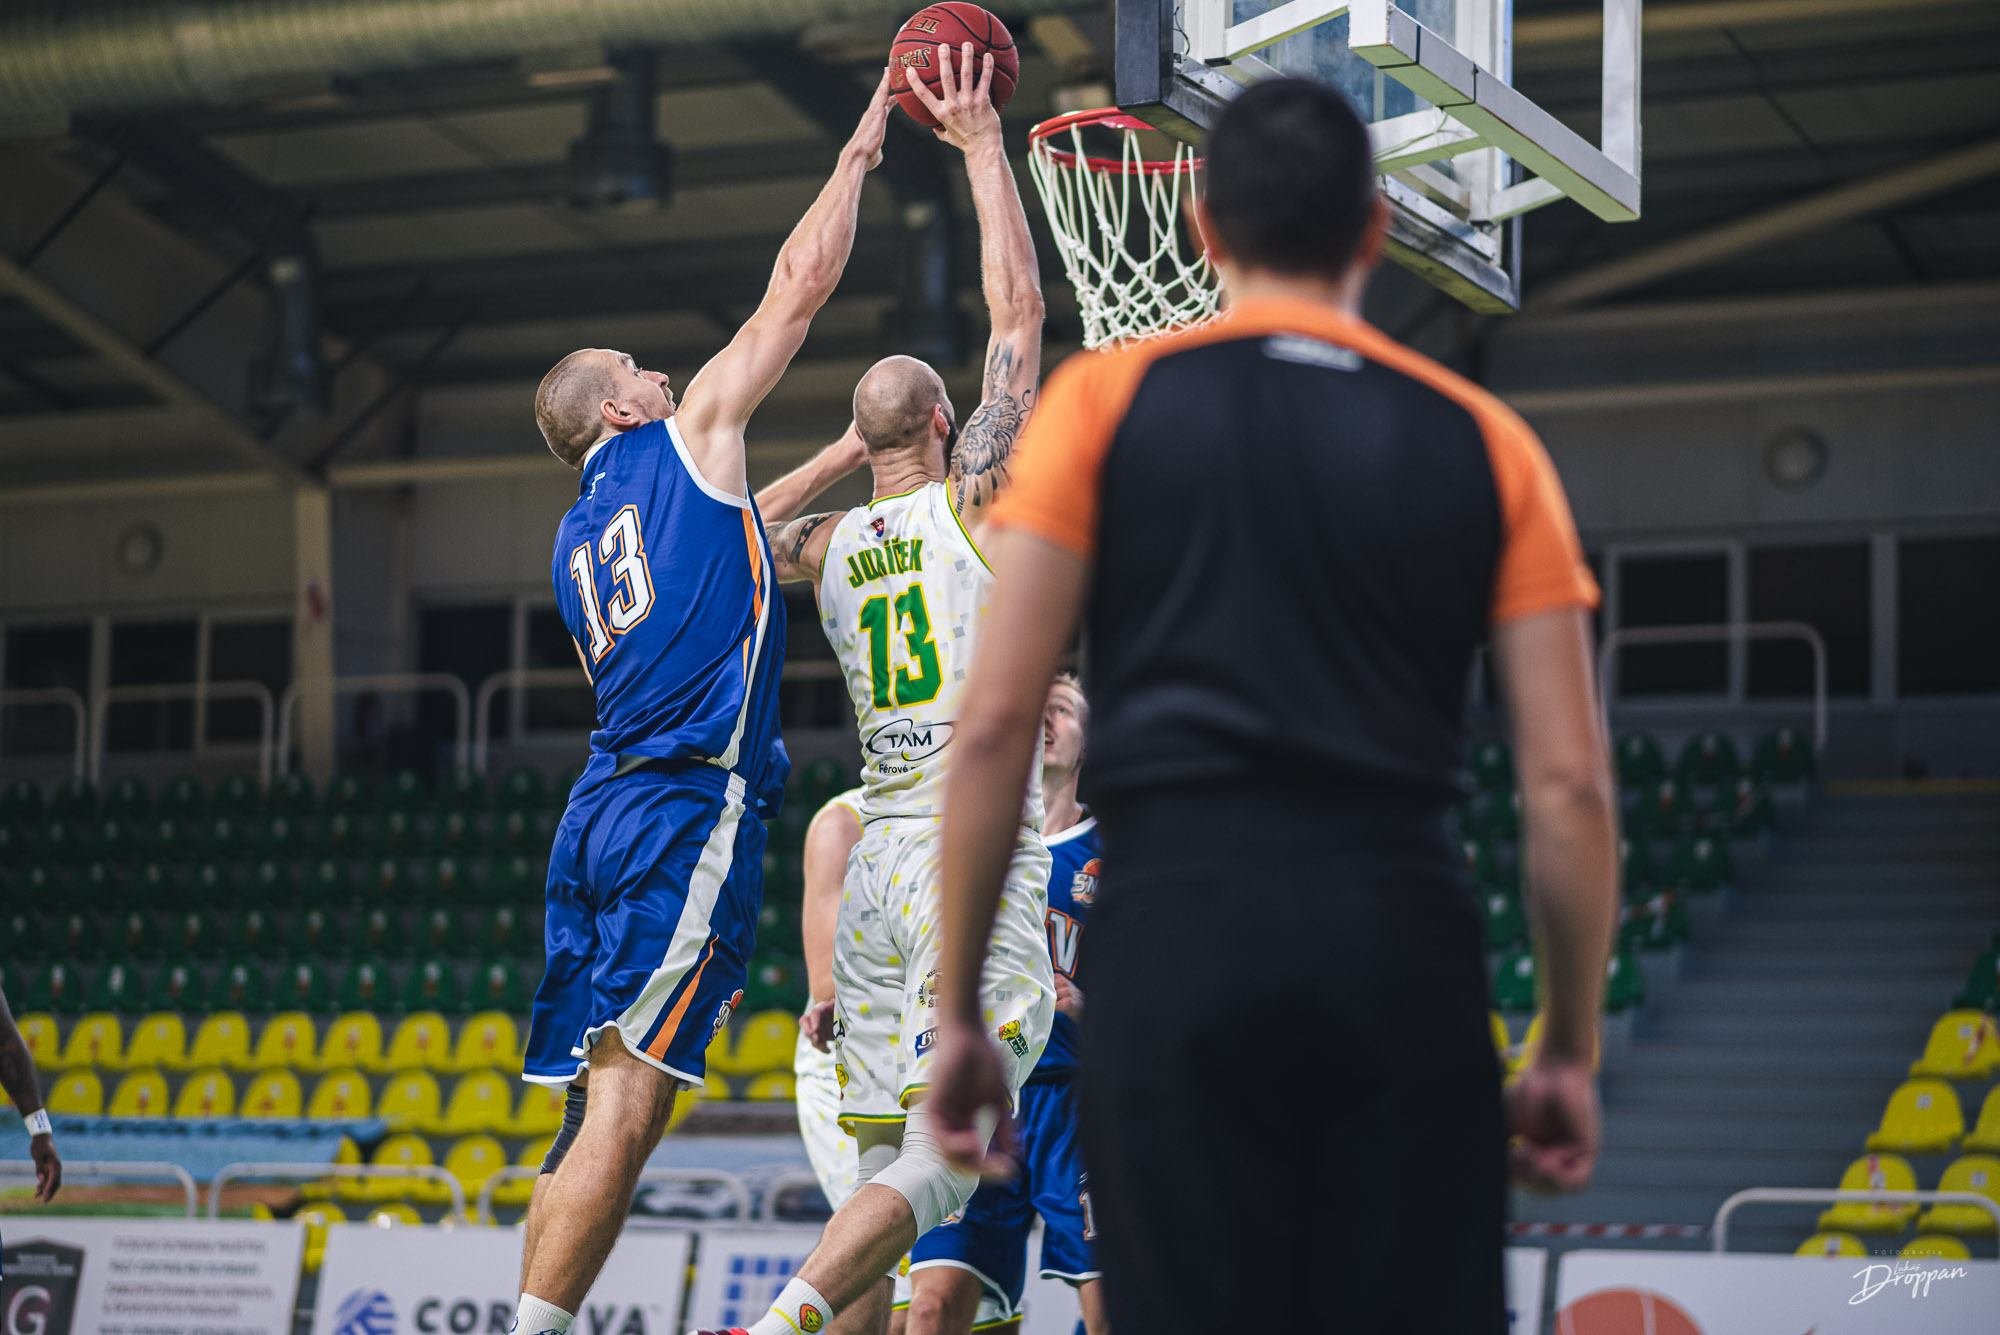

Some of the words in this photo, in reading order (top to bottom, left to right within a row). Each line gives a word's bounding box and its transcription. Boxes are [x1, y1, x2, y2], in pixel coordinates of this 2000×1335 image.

[570, 504, 656, 664] 13
[858, 581, 944, 713] 13
[884, 730, 932, 748] TAM
[879, 763, 908, 773] Férové
[416, 1298, 647, 1335] CORVA
